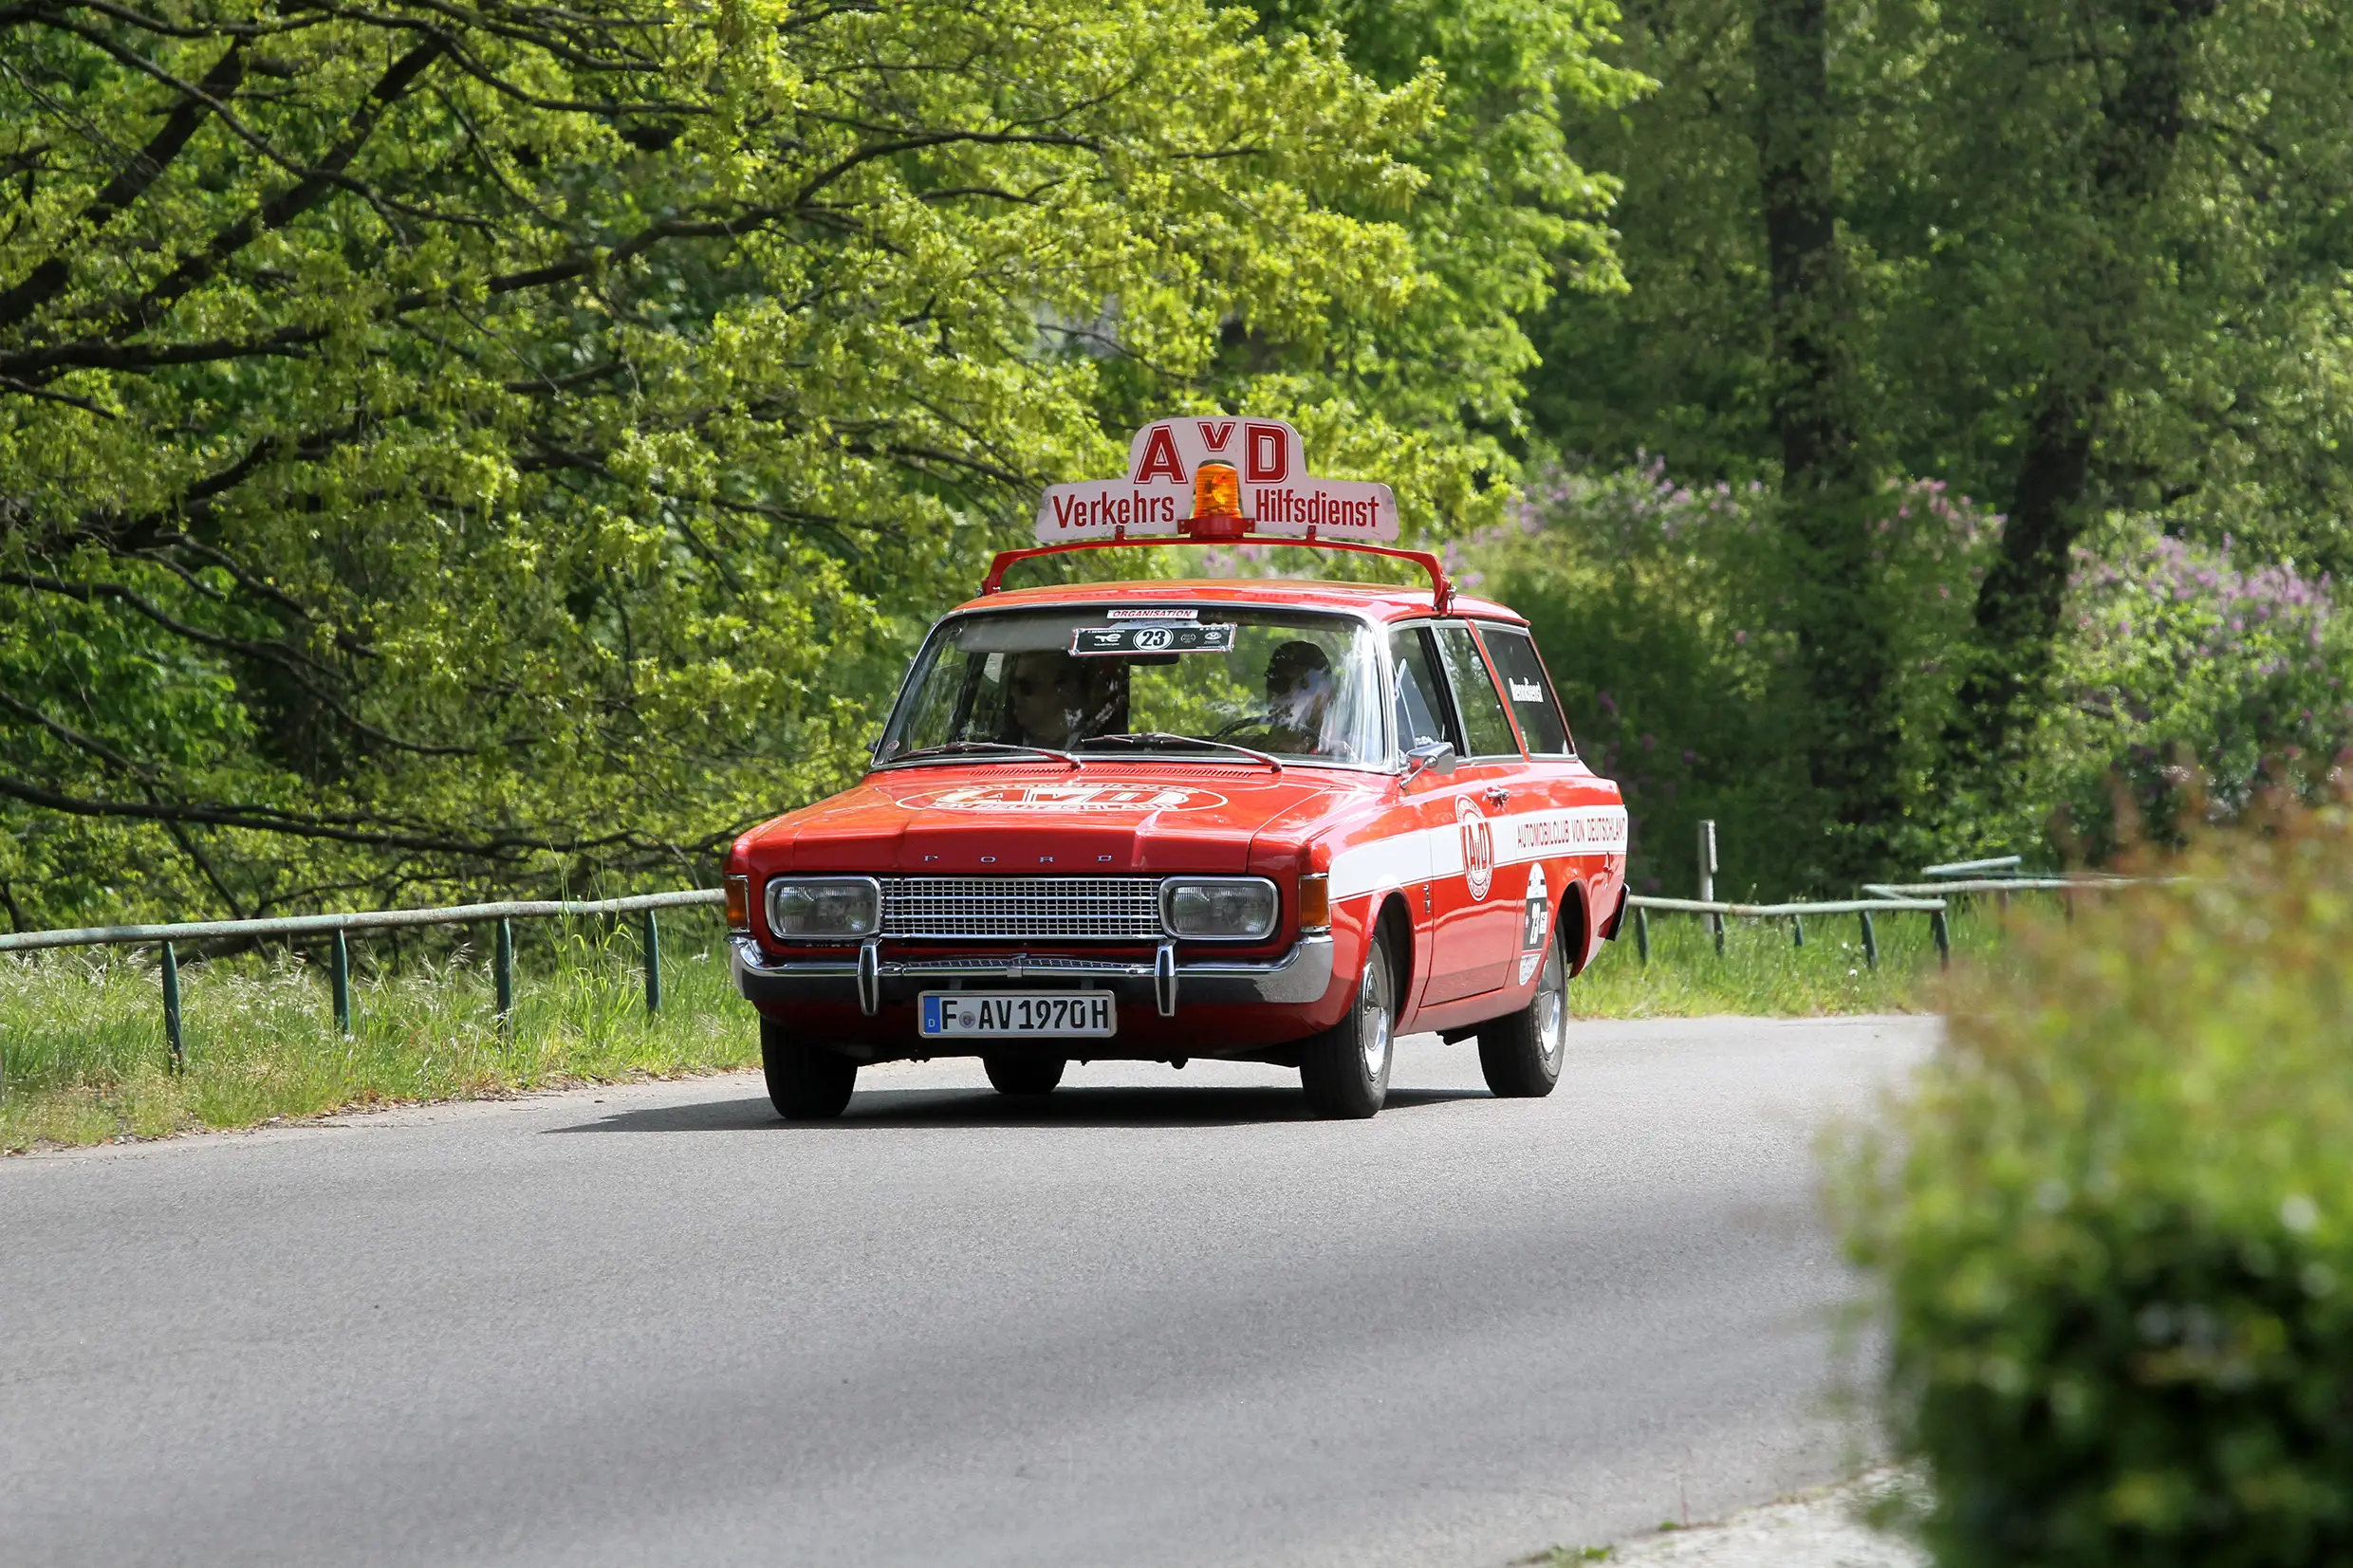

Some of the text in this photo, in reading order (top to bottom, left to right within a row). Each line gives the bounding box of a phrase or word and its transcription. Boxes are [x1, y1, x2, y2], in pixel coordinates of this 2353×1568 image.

[1052, 489, 1380, 528] Verkehrs Hilfsdienst
[1140, 630, 1166, 647] 23
[1517, 820, 1569, 848] AUTOMOBILCLUB
[1571, 819, 1585, 842] VON
[923, 855, 1113, 863] FORD
[928, 1019, 936, 1028] D
